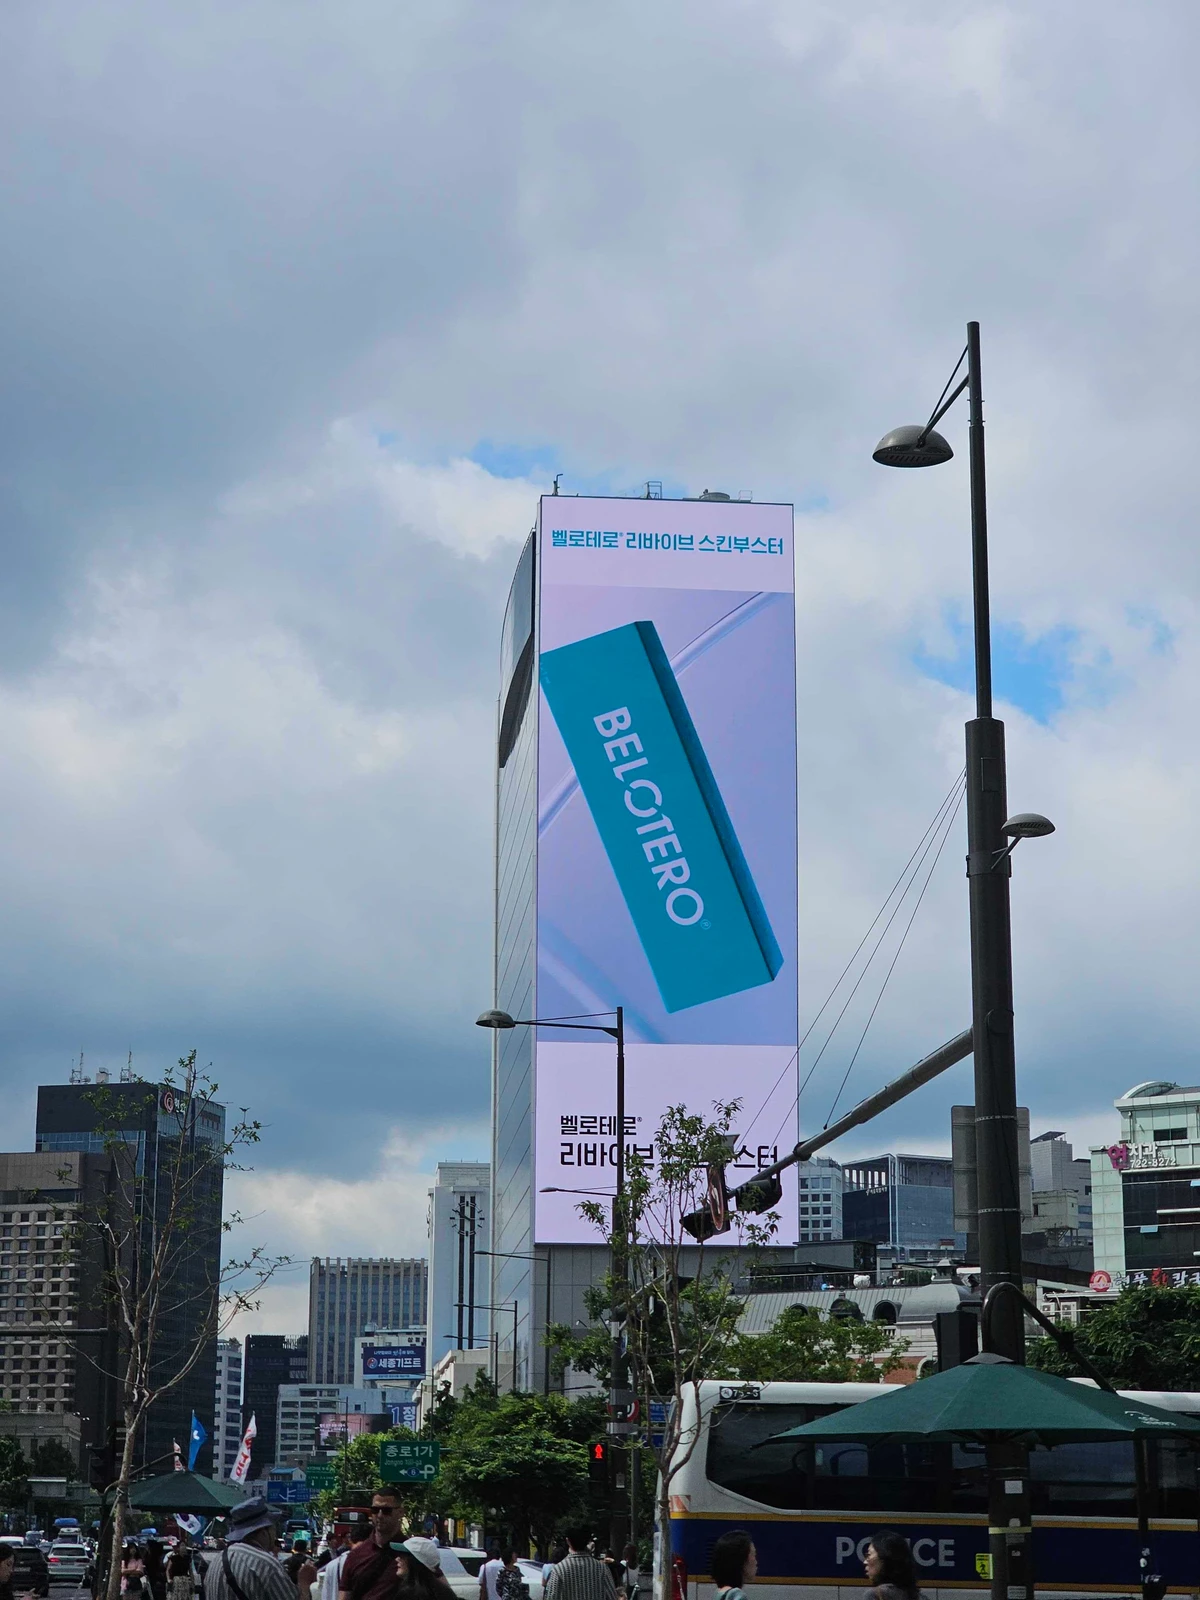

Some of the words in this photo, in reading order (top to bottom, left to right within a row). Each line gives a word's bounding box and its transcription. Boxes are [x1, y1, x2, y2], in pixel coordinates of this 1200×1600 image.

[626, 532, 694, 551] 리바이브
[698, 535, 784, 555] 스킨부스터
[1130, 1157, 1176, 1169] 722-8272
[378, 1357, 422, 1368] 세종기프트
[385, 1445, 434, 1457] 종로1가
[384, 1459, 404, 1467] Jongno
